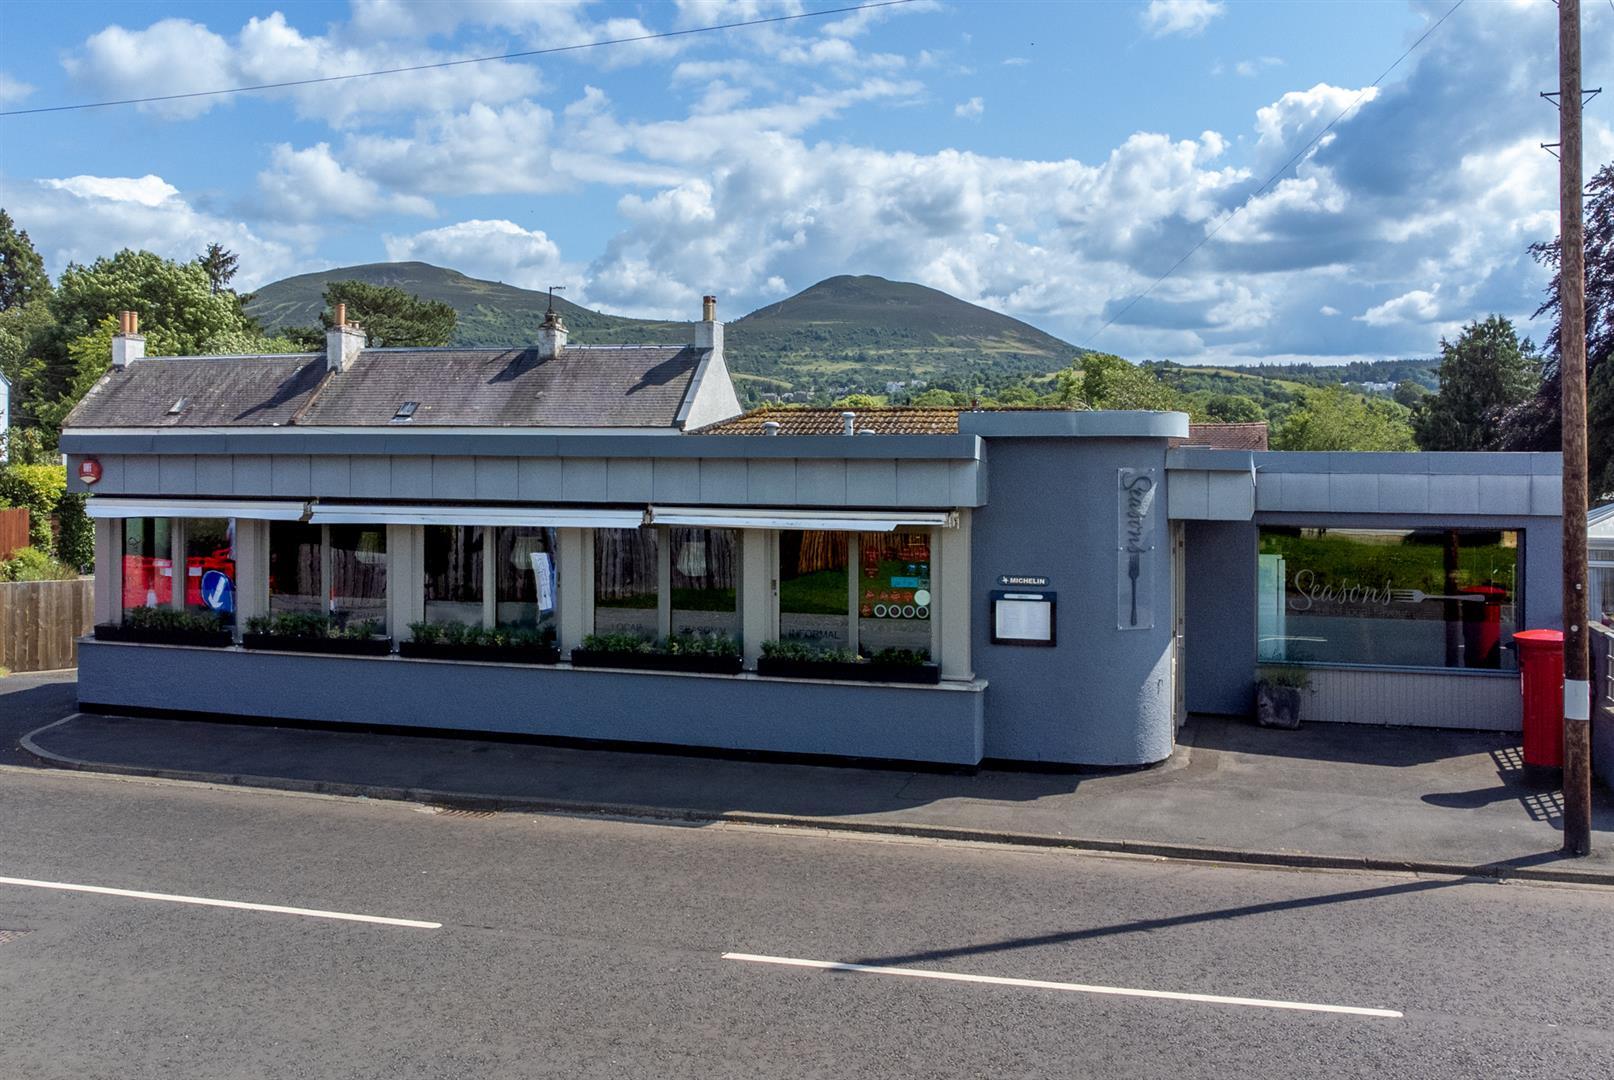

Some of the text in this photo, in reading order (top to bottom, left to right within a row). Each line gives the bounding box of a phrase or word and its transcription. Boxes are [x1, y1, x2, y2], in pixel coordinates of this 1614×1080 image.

[1122, 472, 1152, 553] Seasons
[1009, 577, 1046, 586] MICHELIN
[1289, 569, 1391, 611] Seasons
[788, 629, 841, 640] INFORMAL
